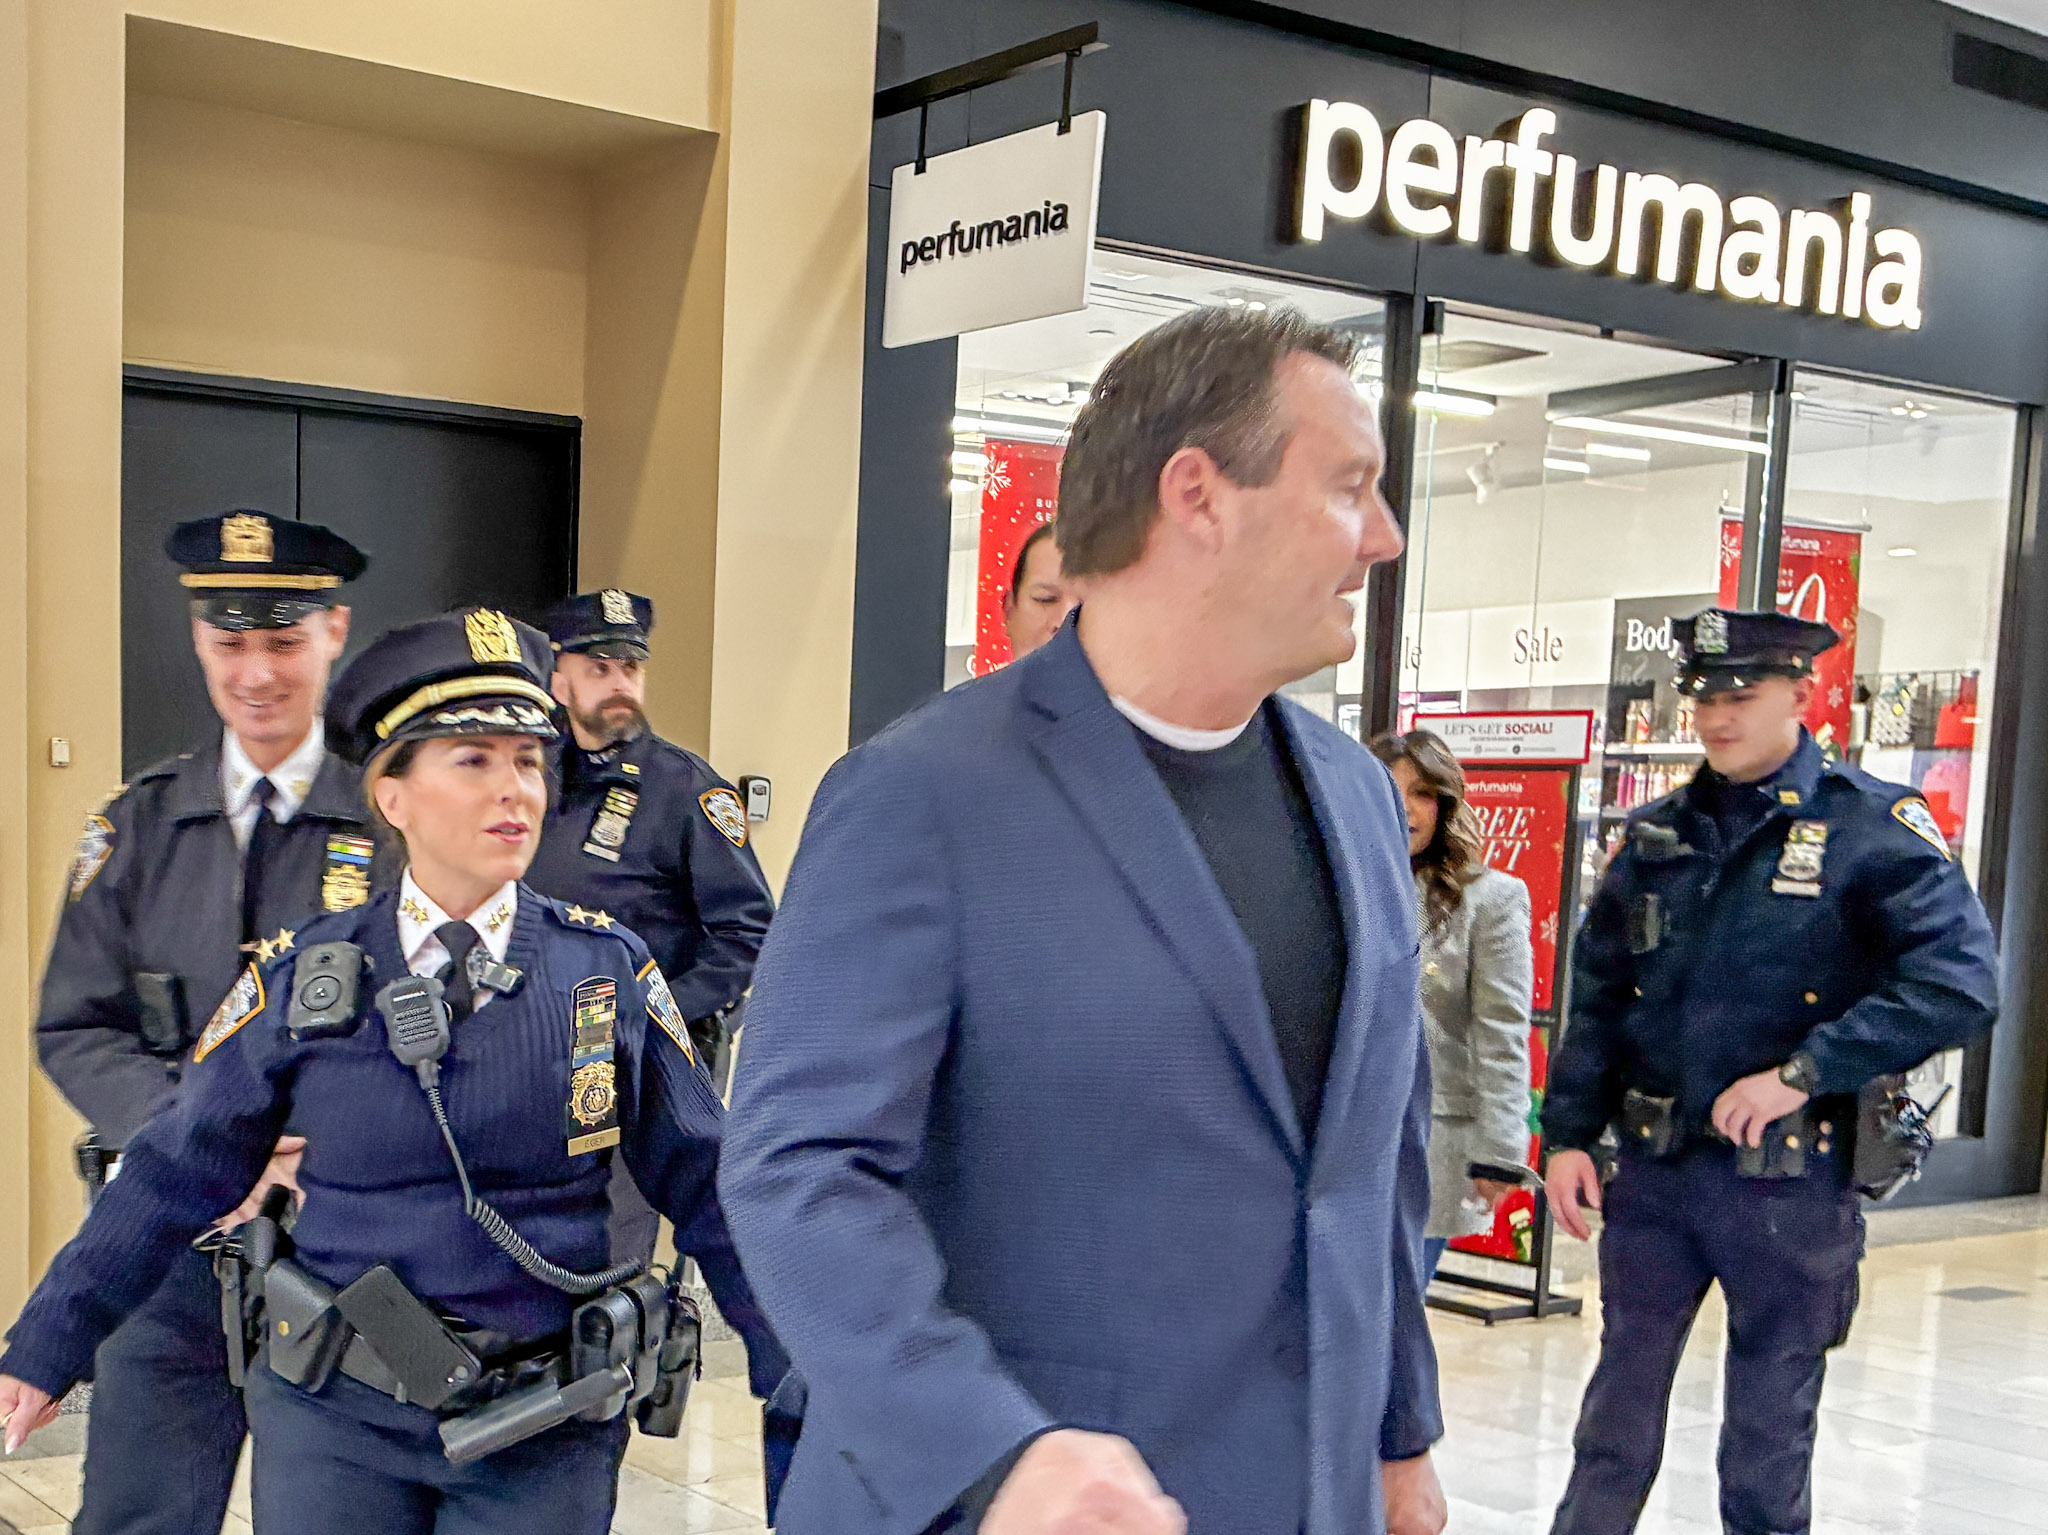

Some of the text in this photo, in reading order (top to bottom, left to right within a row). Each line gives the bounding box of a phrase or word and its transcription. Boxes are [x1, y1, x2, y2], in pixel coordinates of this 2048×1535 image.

[1301, 96, 1922, 331] perfumania
[900, 200, 1069, 275] perfumania
[1513, 627, 1564, 664] Sale
[1478, 722, 1502, 735] GET
[1504, 721, 1553, 735] SOCIAL!
[1475, 806, 1535, 838] REE
